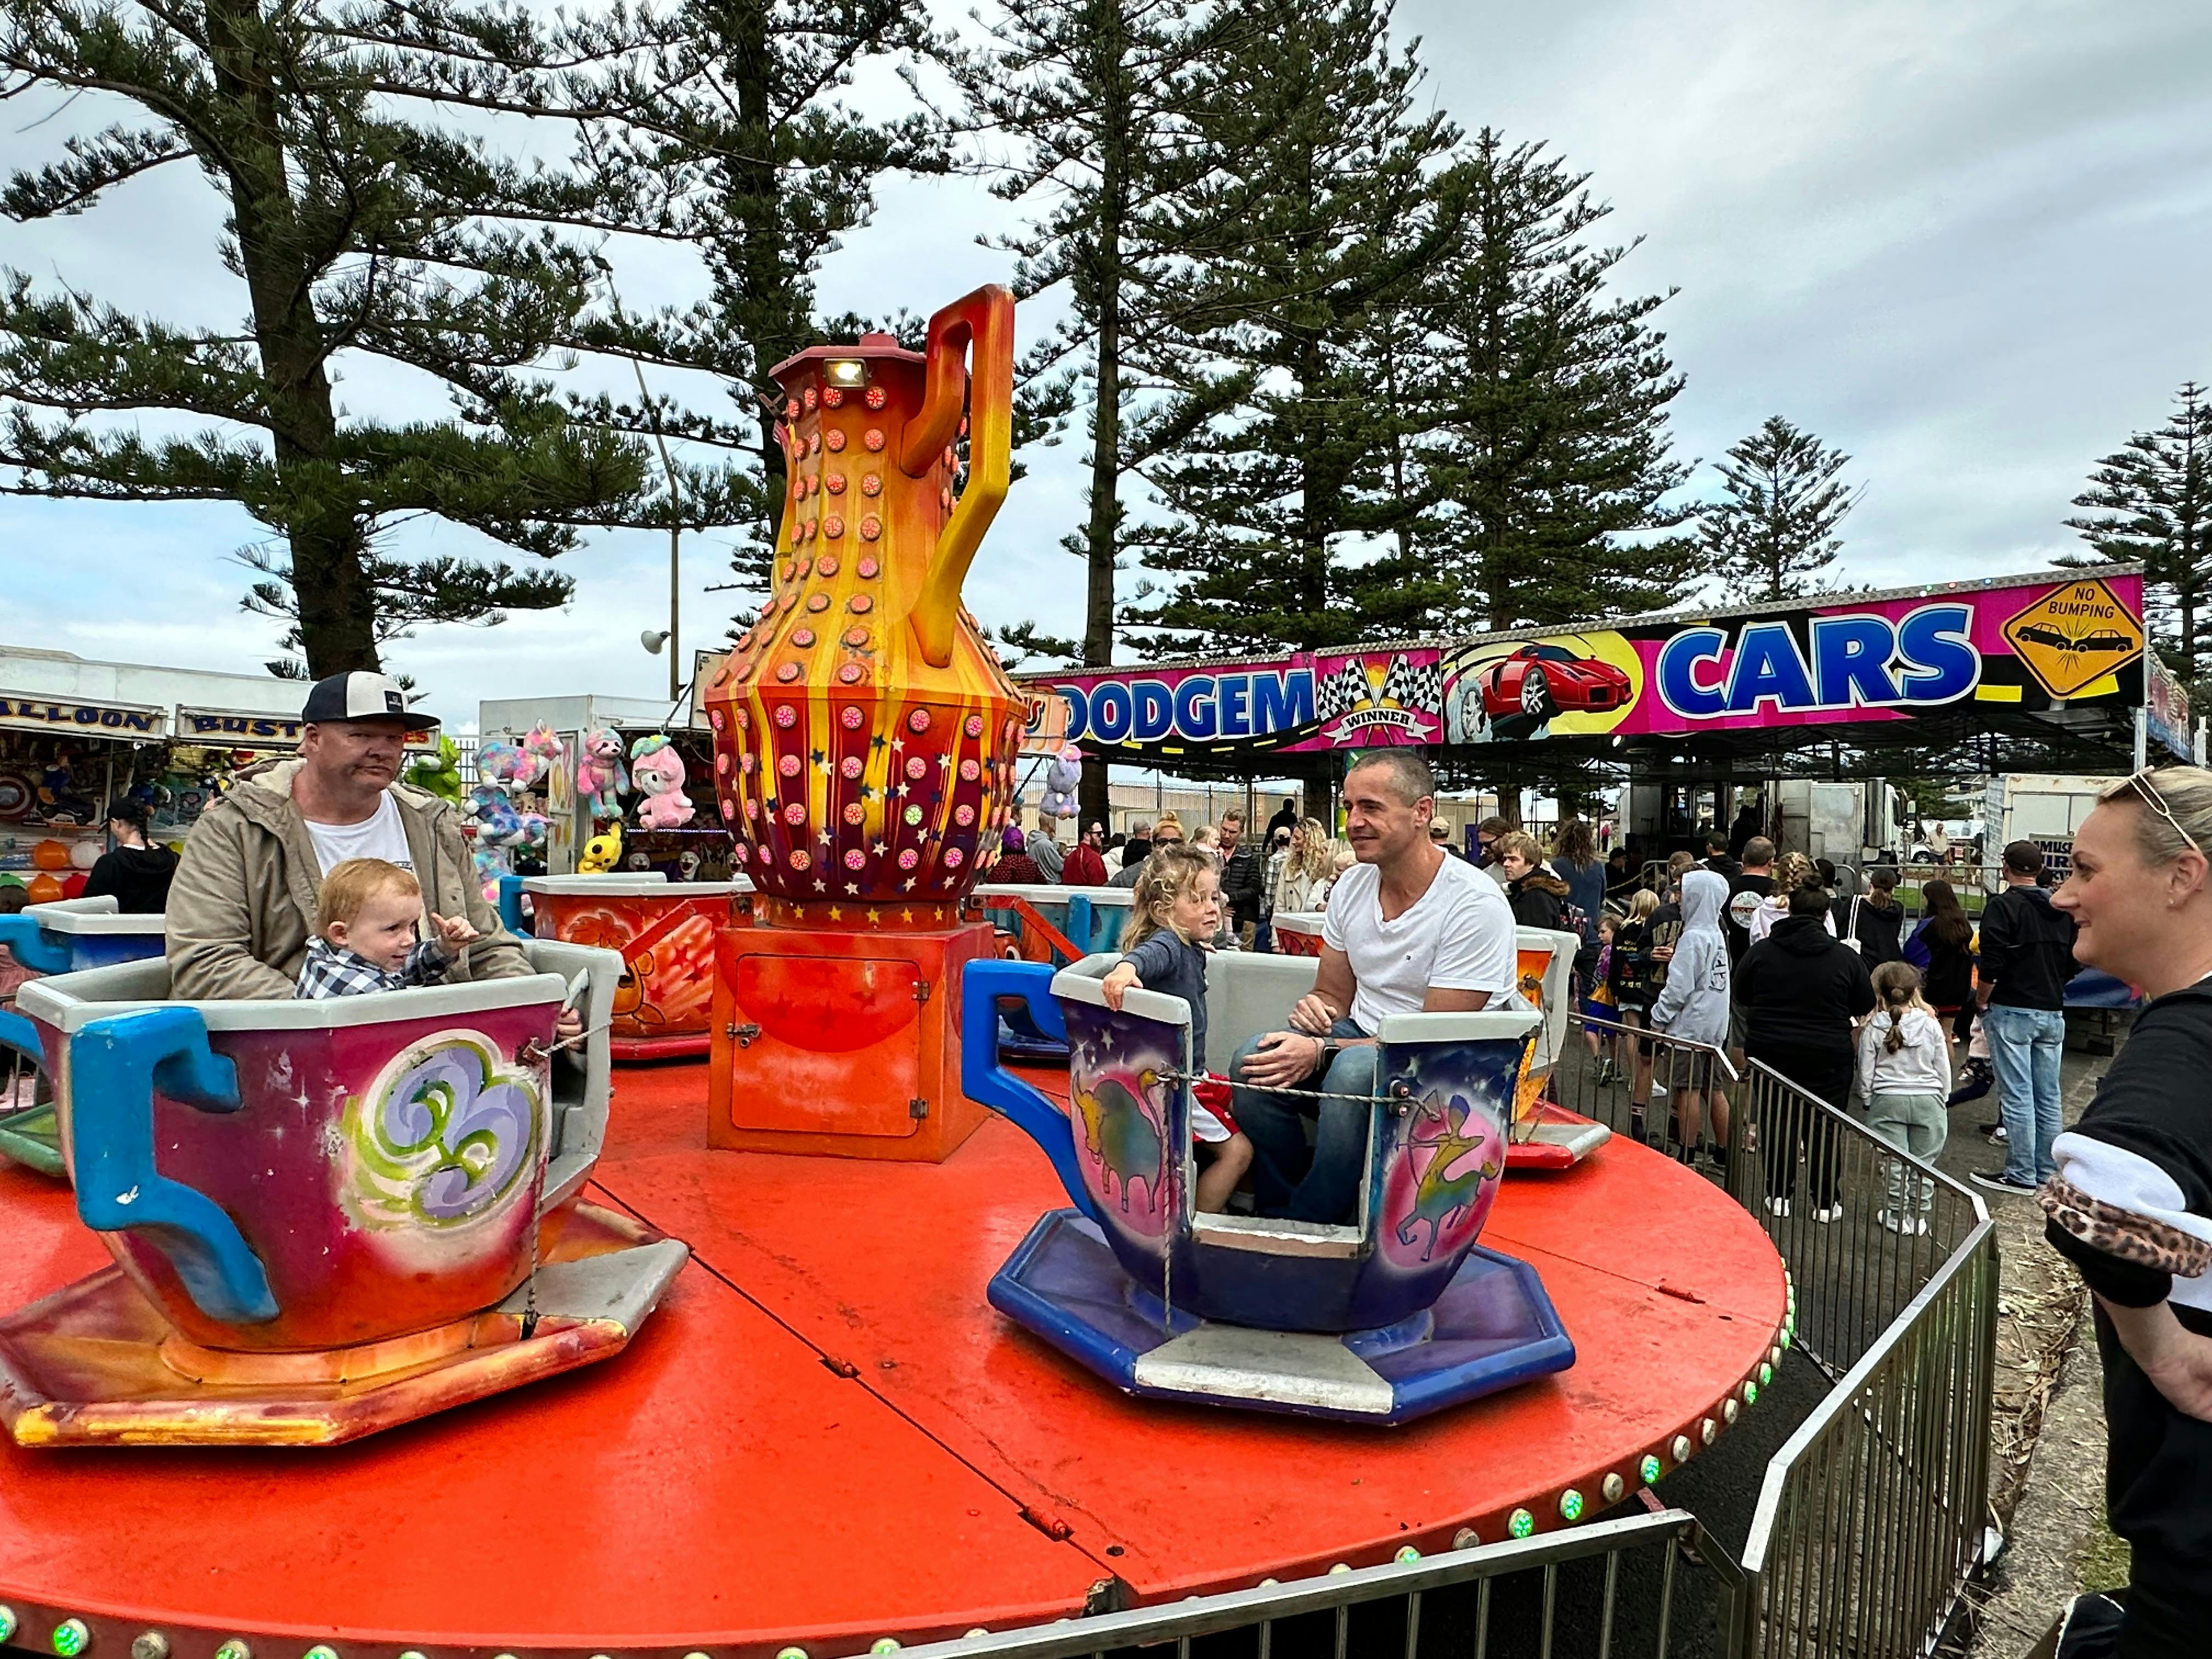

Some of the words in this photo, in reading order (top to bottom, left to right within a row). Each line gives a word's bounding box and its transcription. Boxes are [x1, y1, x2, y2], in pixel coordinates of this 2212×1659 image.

[2074, 588, 2095, 601] NO
[2048, 601, 2114, 619] BUMPING
[1054, 668, 1316, 744] DODGEM
[1656, 602, 1982, 720] CARS
[0, 700, 153, 731] LLOON
[1345, 711, 1410, 727] WINNER
